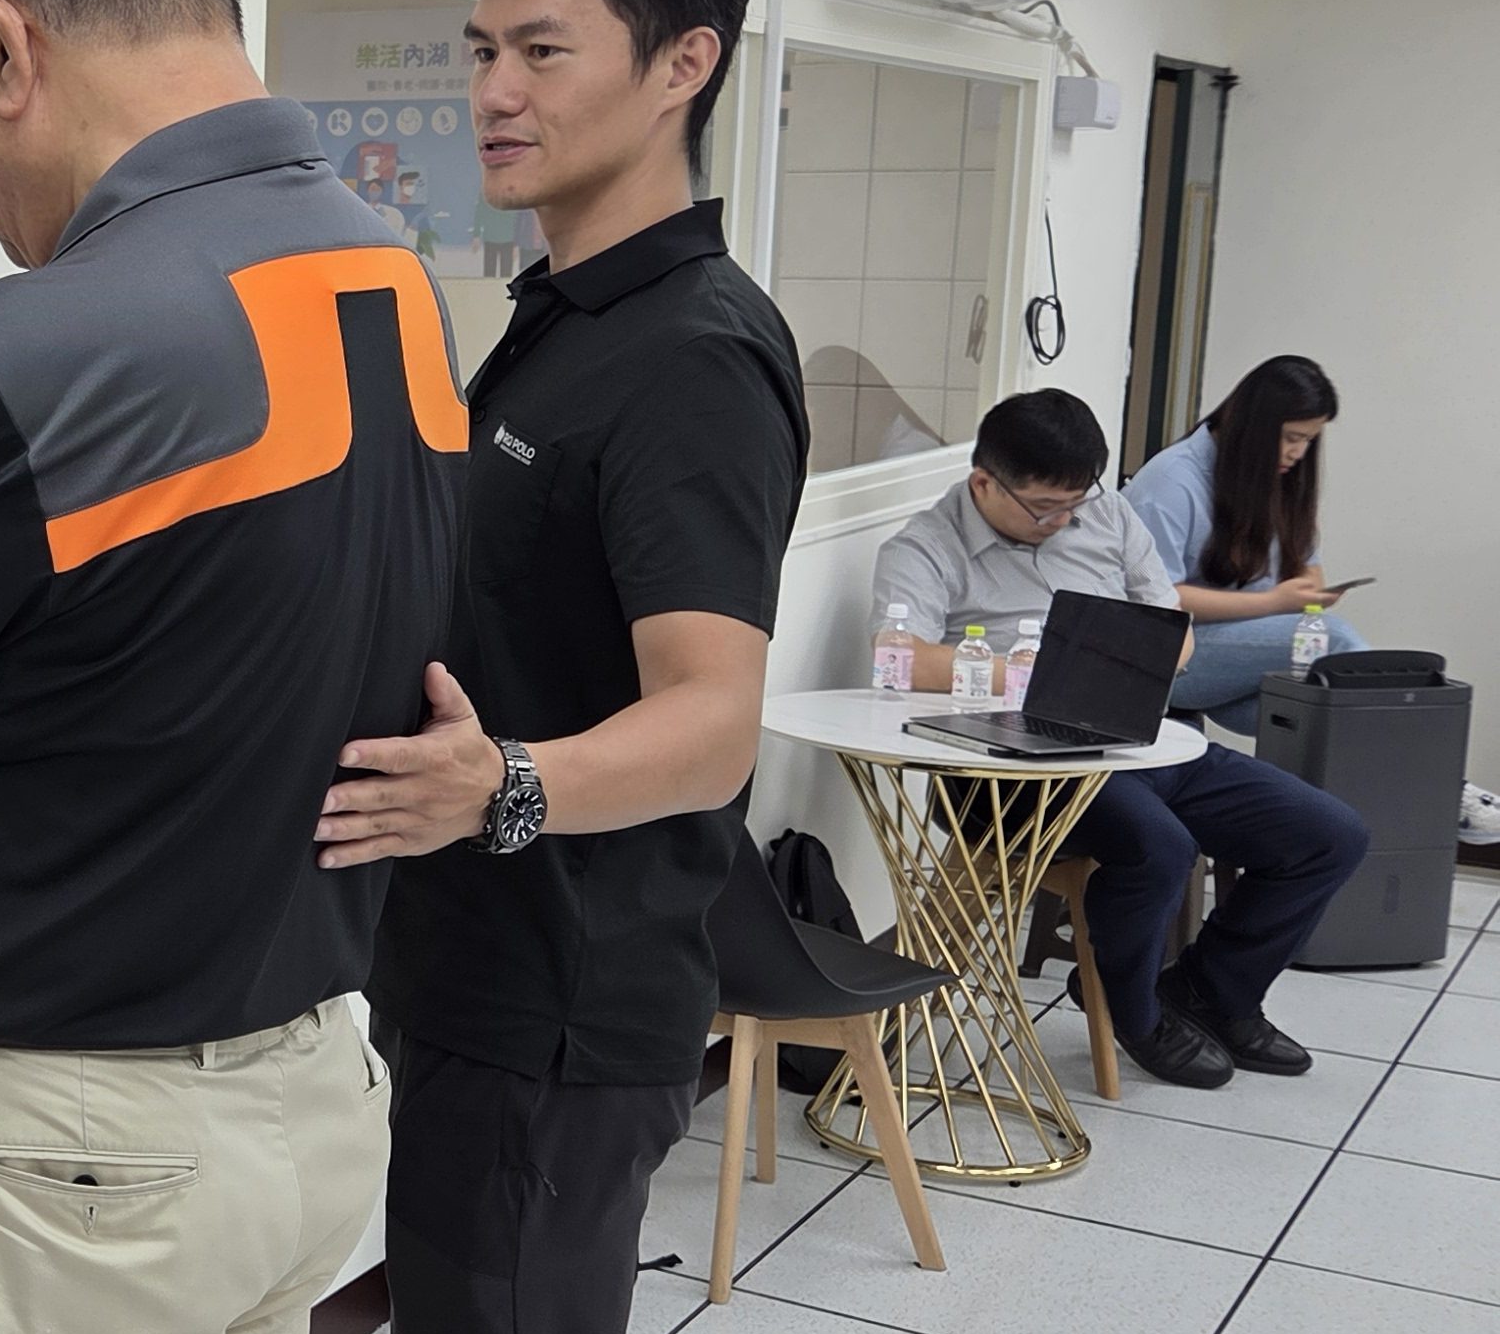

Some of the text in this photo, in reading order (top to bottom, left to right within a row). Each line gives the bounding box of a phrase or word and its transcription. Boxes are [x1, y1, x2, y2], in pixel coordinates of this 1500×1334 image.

[356, 42, 450, 68] 樂活內湖
[512, 438, 536, 459] POLO
